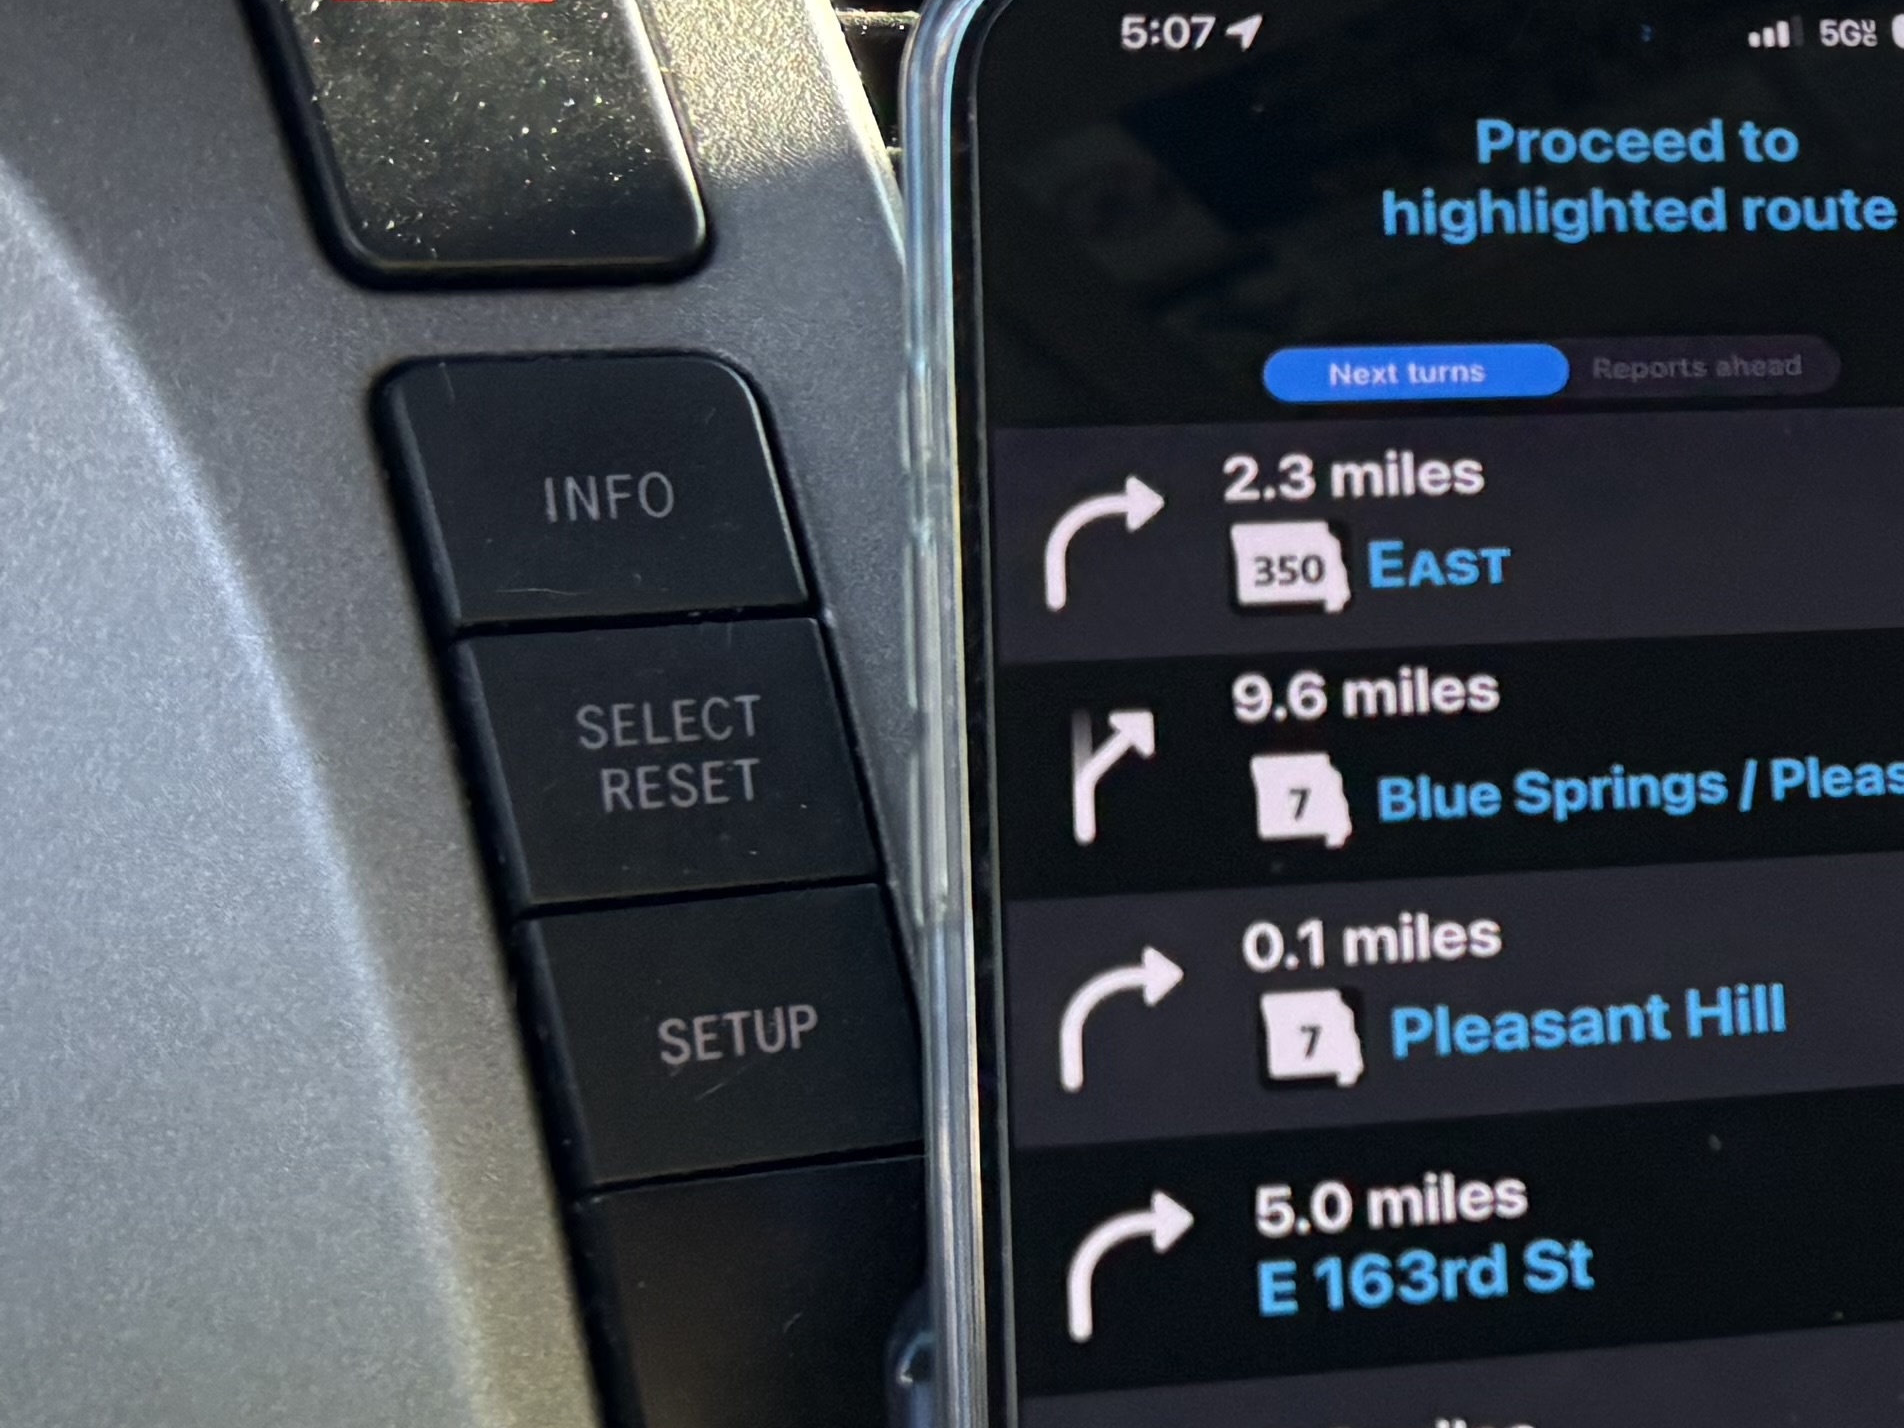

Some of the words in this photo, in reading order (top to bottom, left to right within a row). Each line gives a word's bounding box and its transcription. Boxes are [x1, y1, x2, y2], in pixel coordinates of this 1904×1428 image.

[1121, 14, 1216, 50] 5:07
[1476, 117, 1725, 164] Proceed
[1738, 120, 1799, 163] to
[1382, 186, 1727, 245] highlighted
[1742, 189, 1897, 232] route
[1329, 362, 1399, 387] Next
[1406, 362, 1486, 385] turns
[1592, 355, 1708, 383] Reports
[1715, 353, 1804, 378] ahead
[544, 471, 674, 523] INFO
[1223, 453, 1316, 502] 2.3
[1330, 449, 1485, 498] miles
[1254, 554, 1326, 586] 350
[575, 694, 761, 750] SELECT
[1232, 671, 1328, 723] 9.6
[1342, 666, 1500, 717] miles
[600, 757, 760, 813] RESET
[1289, 787, 1310, 820] 7
[1378, 774, 1502, 822] Blue
[1514, 764, 1729, 822] Springs
[1739, 759, 1758, 812] /
[1242, 919, 1325, 972] 0.1
[1343, 912, 1502, 965] miles
[657, 1004, 818, 1066] SETUP
[1300, 1025, 1321, 1058] 7
[1391, 994, 1671, 1059] Pleasant
[1685, 983, 1786, 1038] Hill
[1256, 1181, 1353, 1237] 5.0
[1367, 1172, 1528, 1228] miles
[1258, 1260, 1298, 1316] E
[1314, 1243, 1508, 1310] 163rd
[1523, 1238, 1595, 1293] St
